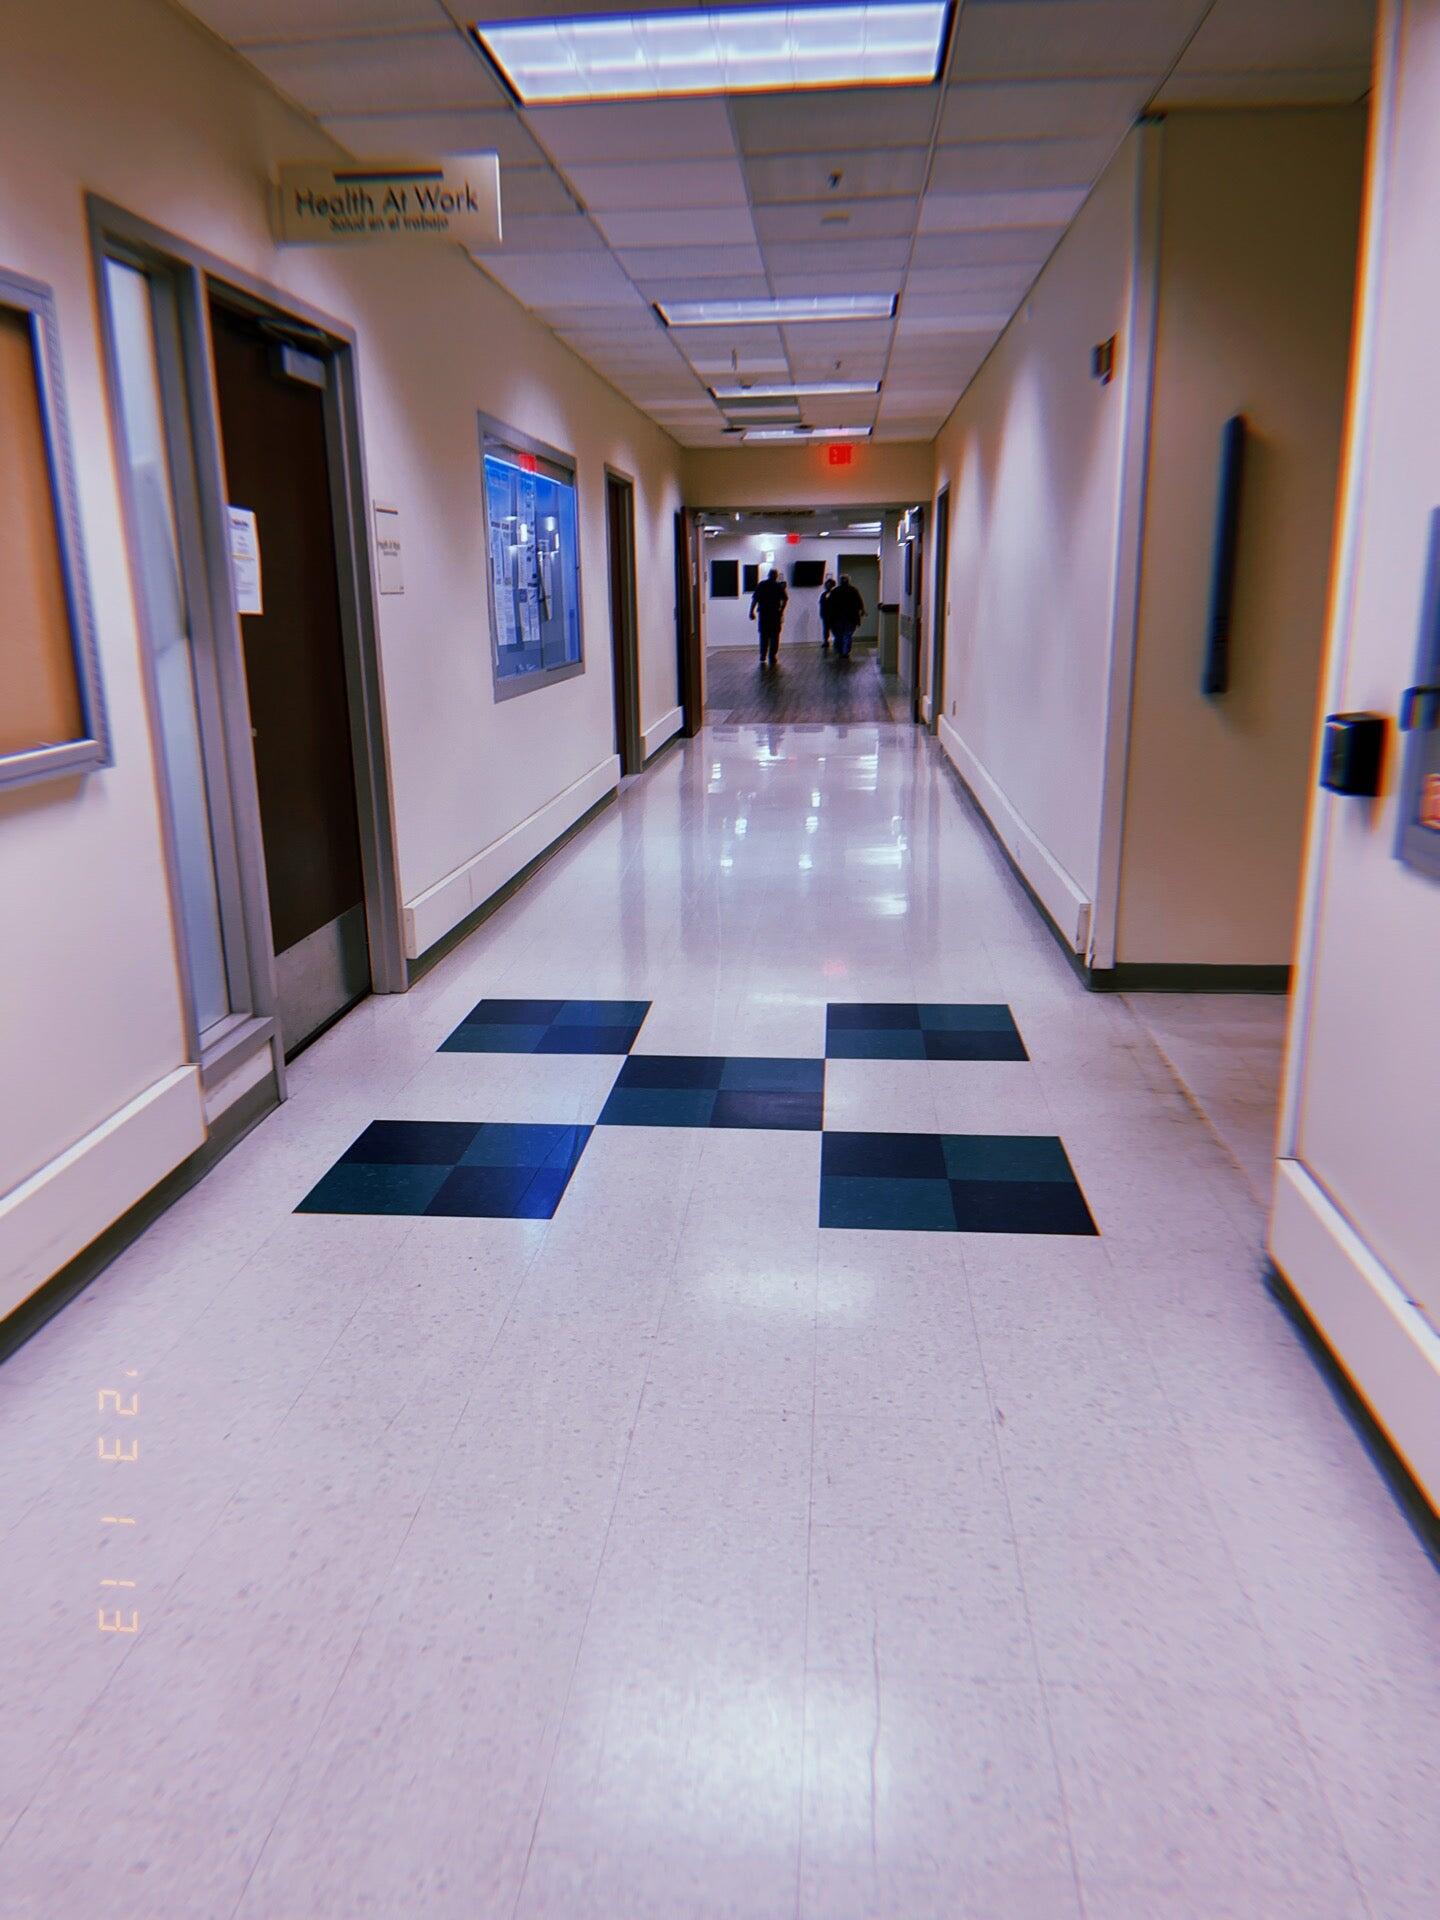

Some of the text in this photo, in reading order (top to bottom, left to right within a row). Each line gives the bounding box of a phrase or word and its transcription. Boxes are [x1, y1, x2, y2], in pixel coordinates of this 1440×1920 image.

[295, 180, 479, 216] Health At Work
[829, 445, 852, 465] EIT
